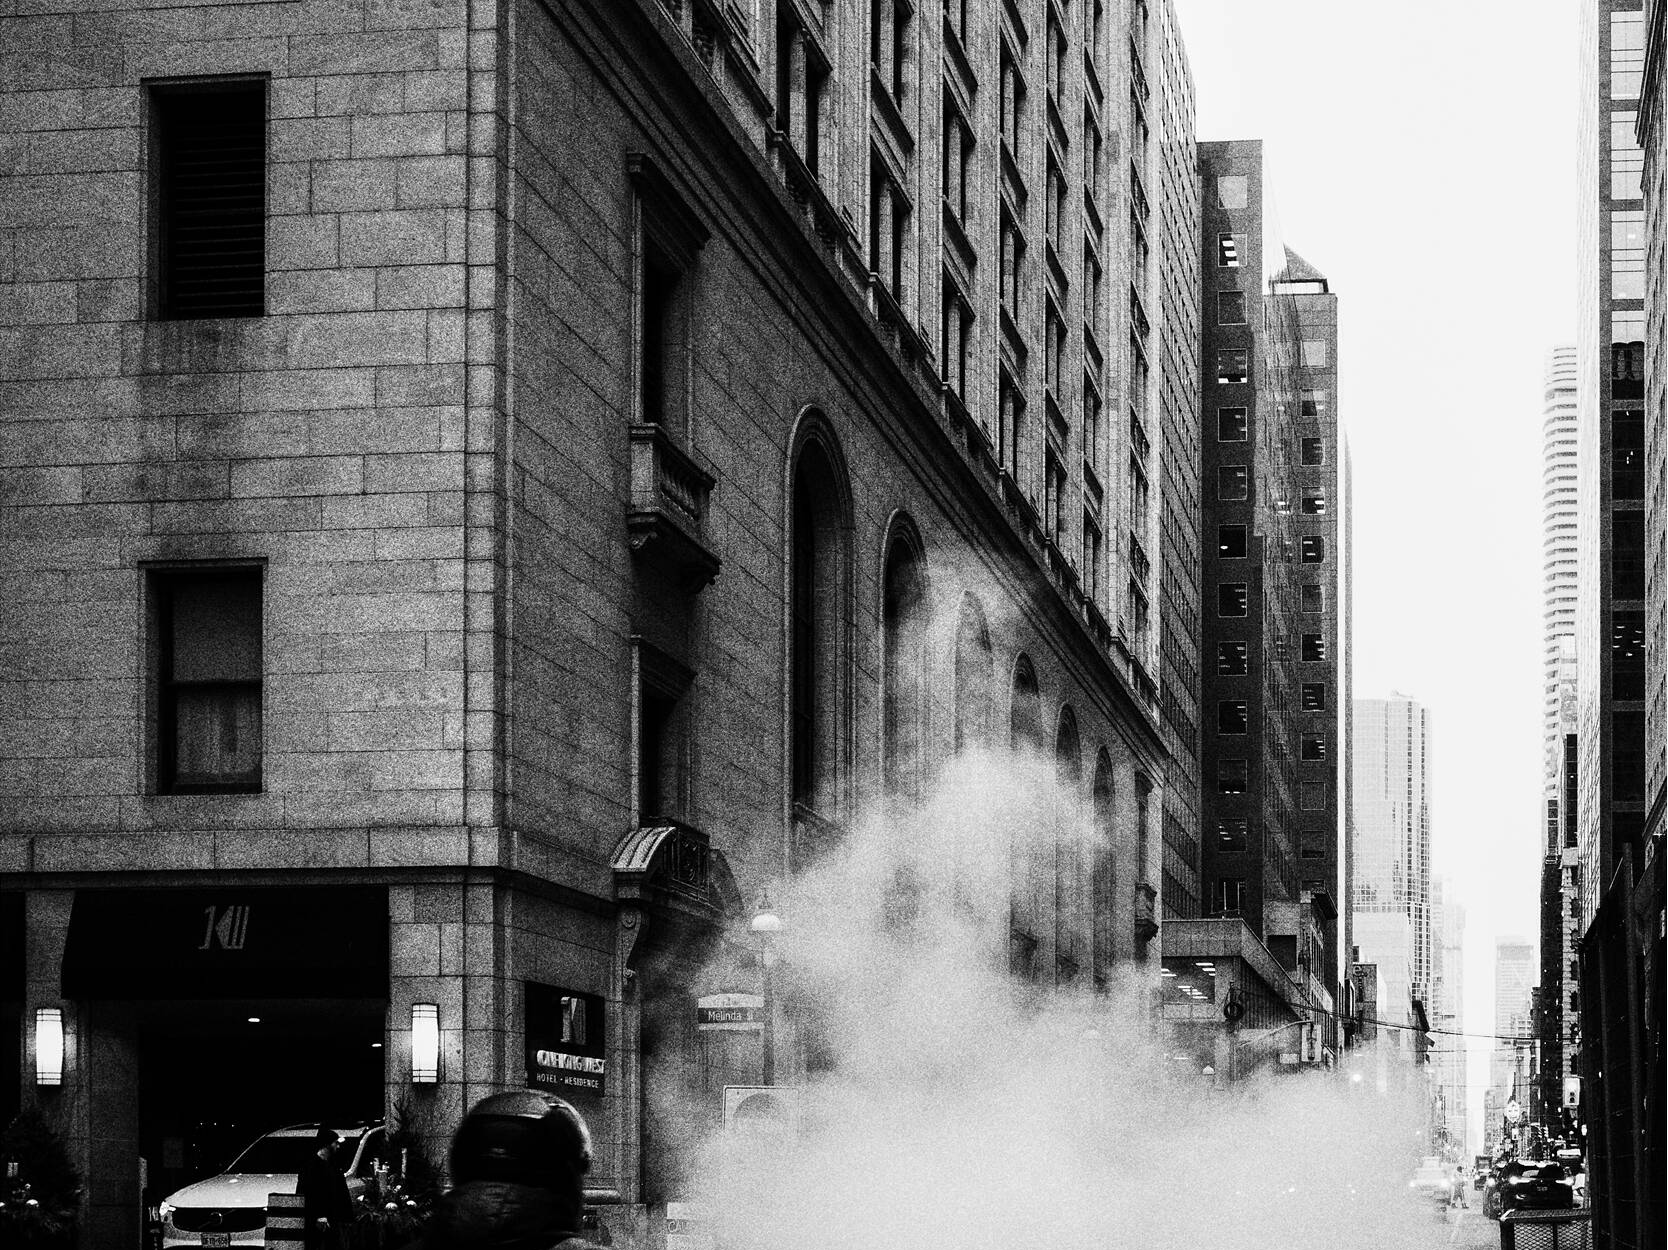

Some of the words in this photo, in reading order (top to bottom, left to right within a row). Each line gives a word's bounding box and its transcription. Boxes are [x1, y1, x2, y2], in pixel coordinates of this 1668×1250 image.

[708, 1009, 742, 1021] Melinda
[536, 1072, 558, 1083] HOTEL
[564, 1076, 600, 1089] RESIDENCE
